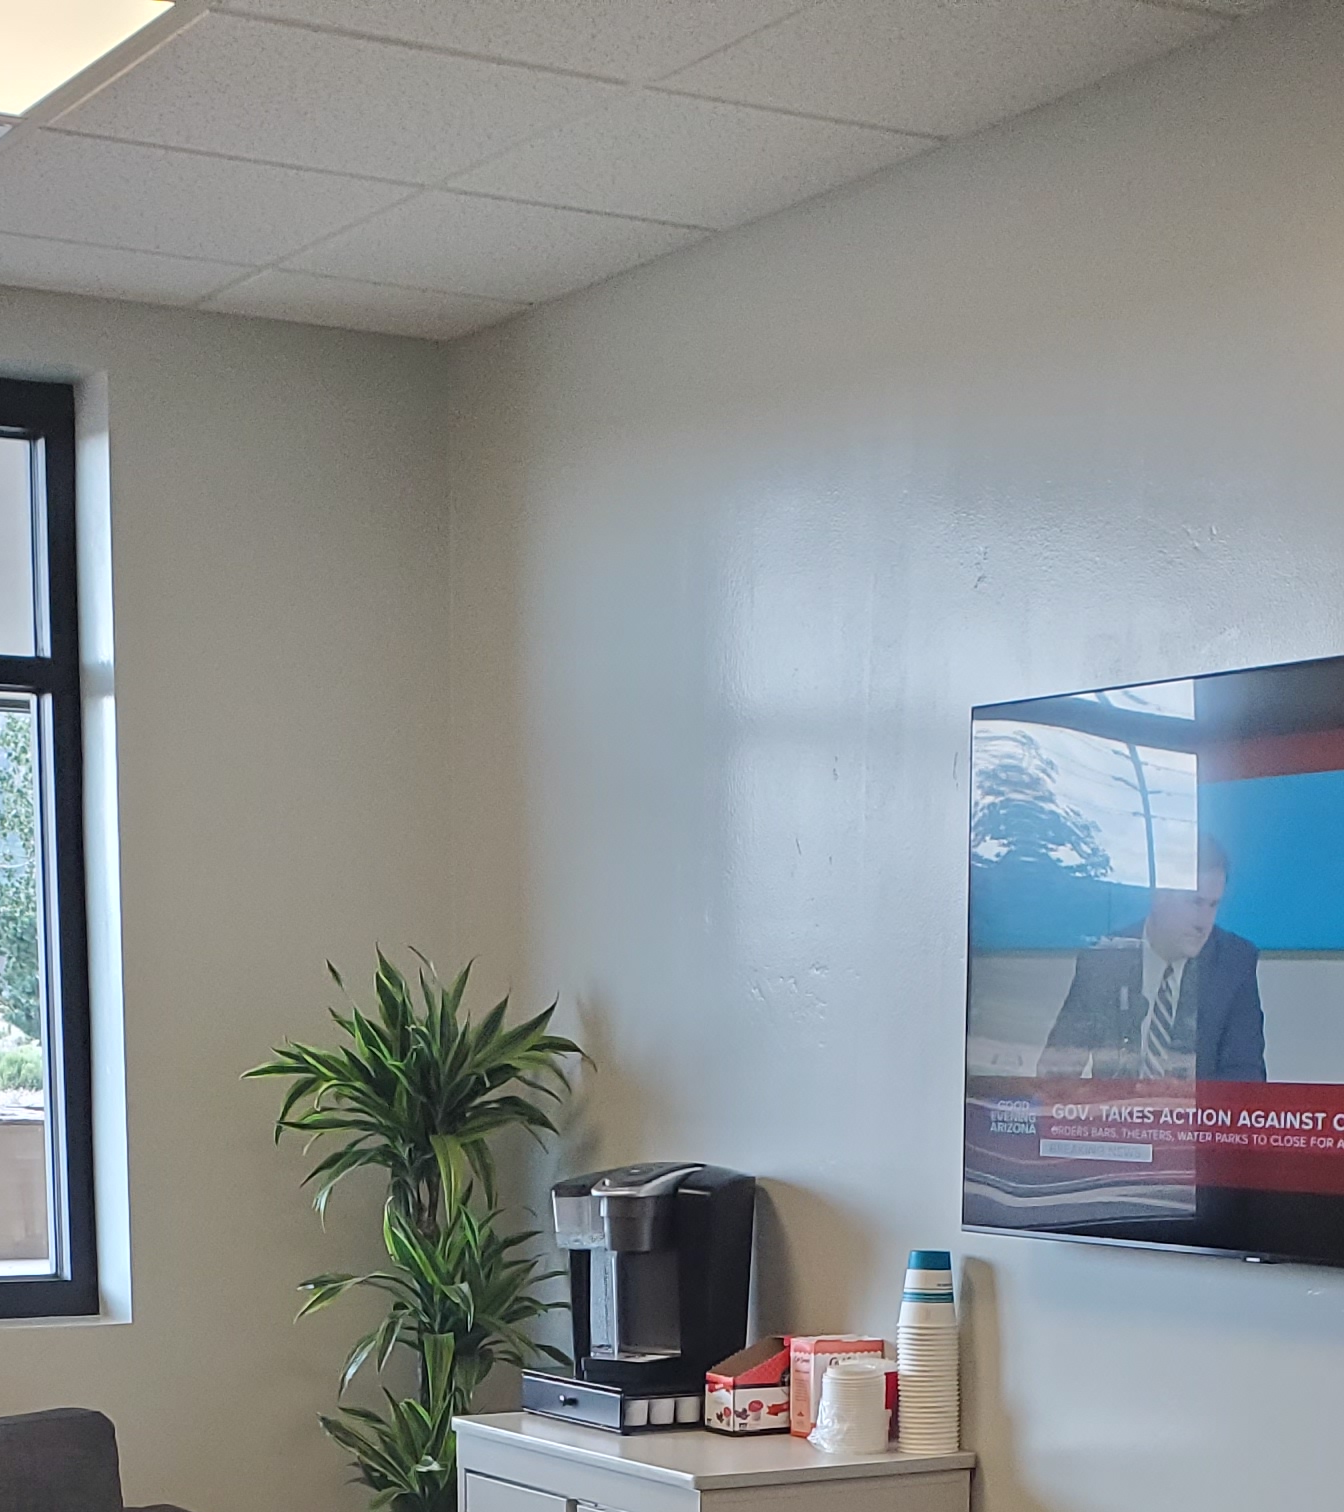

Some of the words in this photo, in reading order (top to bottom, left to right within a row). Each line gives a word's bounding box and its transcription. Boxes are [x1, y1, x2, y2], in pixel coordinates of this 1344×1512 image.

[990, 1121, 1036, 1134] ARIZONA
[1052, 1103, 1094, 1121] GOV.
[1099, 1105, 1154, 1124] TAKES
[1159, 1107, 1232, 1127] ACTION
[1237, 1110, 1327, 1131] AGAINST
[1050, 1125, 1089, 1137] ORDERS
[1177, 1131, 1213, 1143] WATER
[1215, 1132, 1249, 1145] PARKS
[1252, 1133, 1267, 1146] TO
[1270, 1135, 1307, 1148] CLOSE
[1310, 1136, 1334, 1149] FOR
